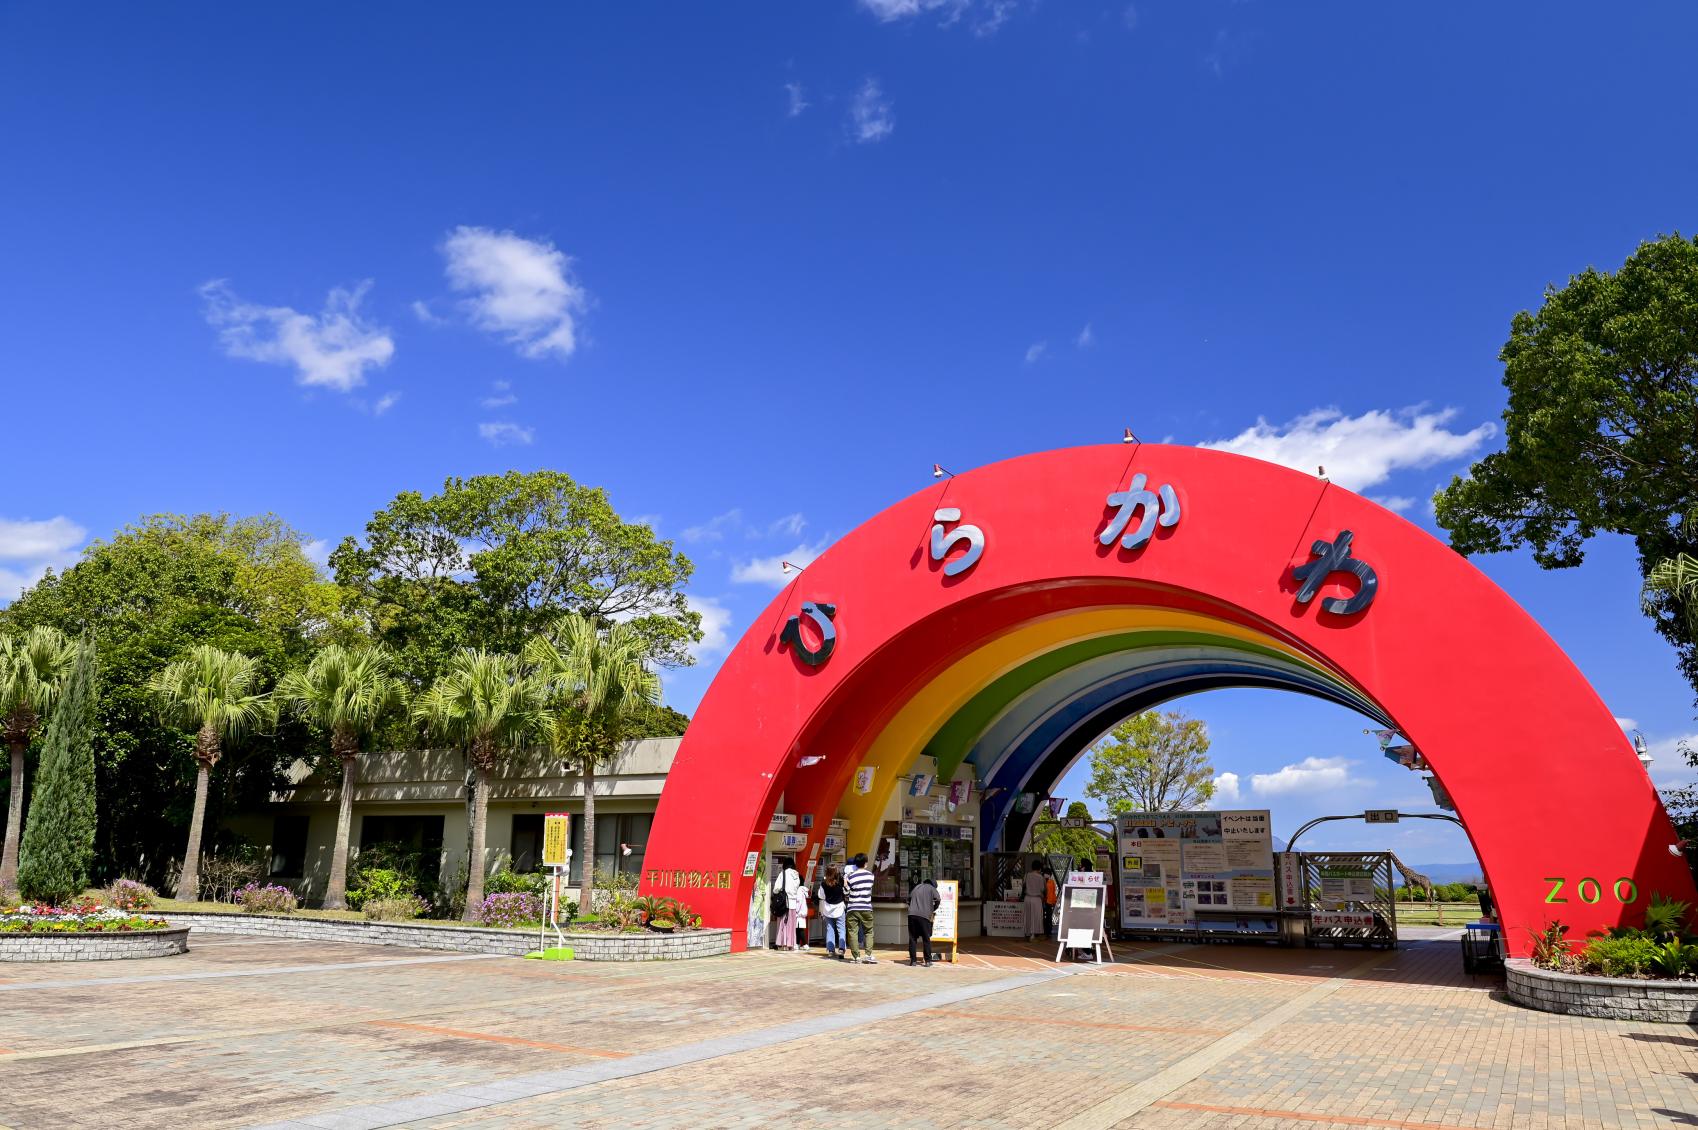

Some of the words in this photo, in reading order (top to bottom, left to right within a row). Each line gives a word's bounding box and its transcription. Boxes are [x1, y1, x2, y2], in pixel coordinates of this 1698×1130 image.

[780, 473, 1379, 667] ひらかわ
[1064, 819, 1080, 827] 入口
[1370, 812, 1394, 821] 出口
[1130, 840, 1142, 848] 本日
[646, 869, 732, 889] 平川動物公園
[1543, 876, 1639, 905] ZOO
